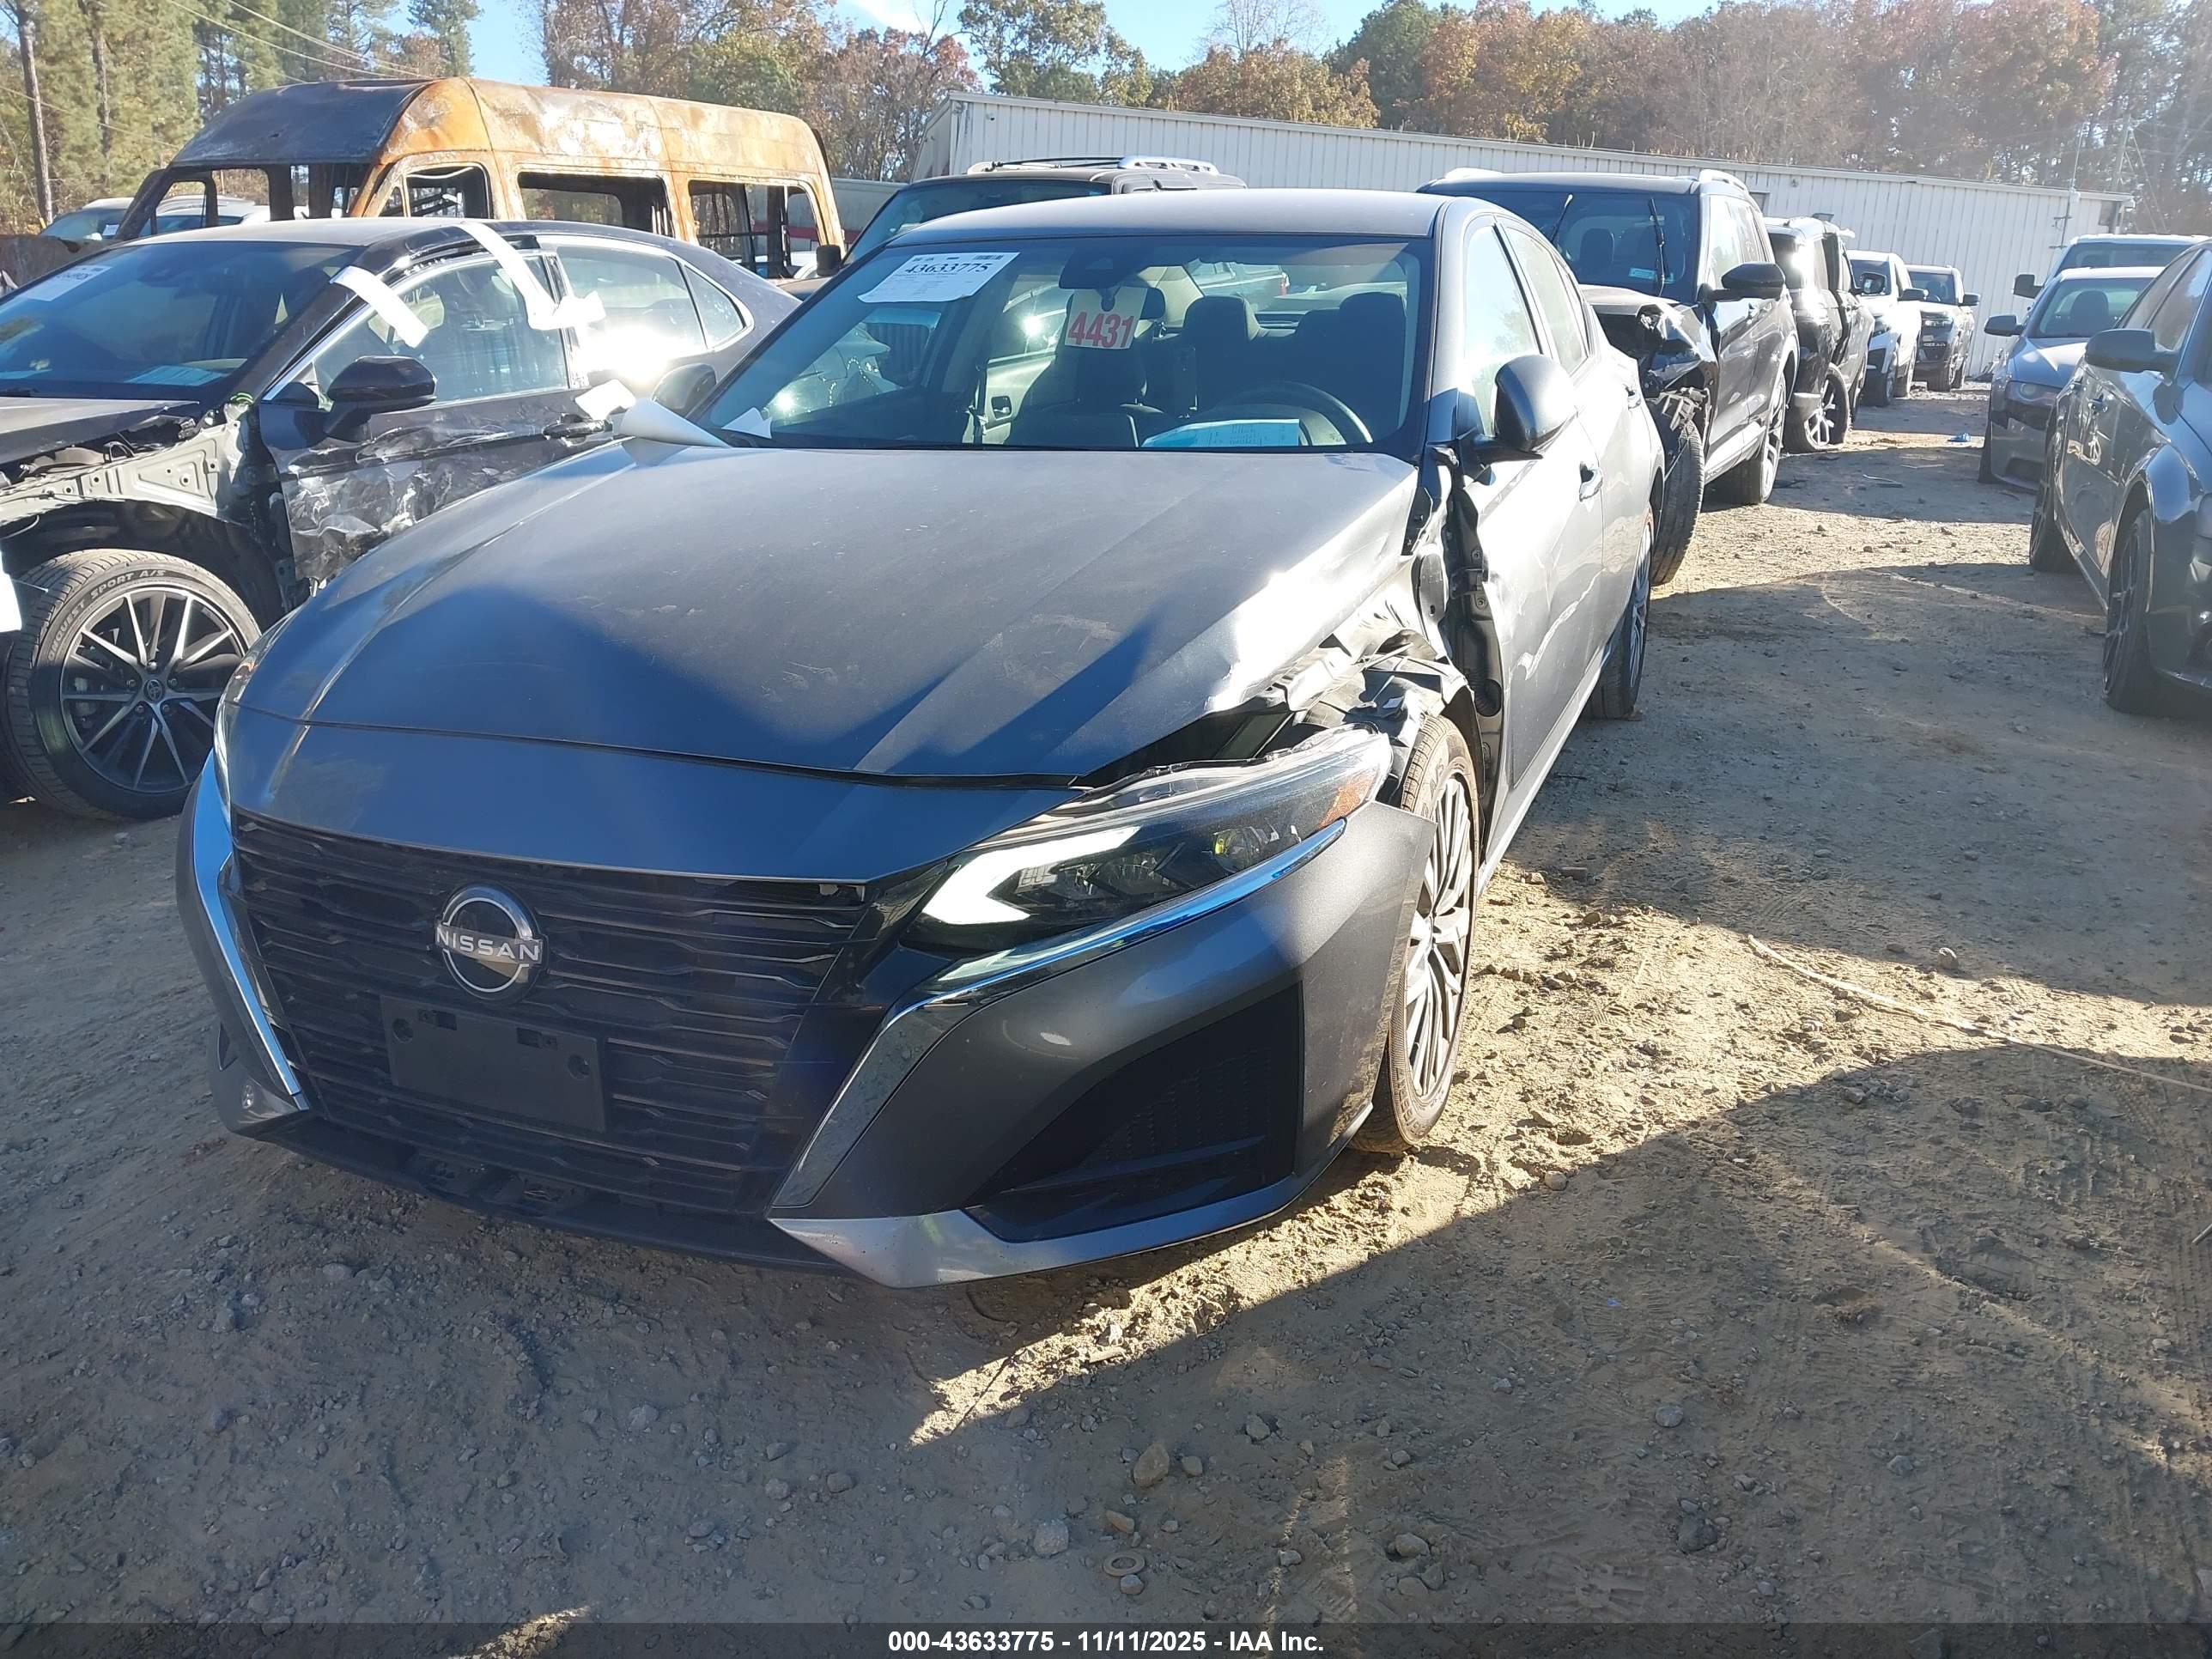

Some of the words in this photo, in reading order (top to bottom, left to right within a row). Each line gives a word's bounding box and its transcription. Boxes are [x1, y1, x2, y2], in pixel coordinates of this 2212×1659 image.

[905, 263, 994, 274] 43633775
[1067, 312, 1134, 348] 4431
[48, 599, 85, 661] ONQUEST
[90, 573, 134, 599] SPORT
[436, 927, 538, 961] NISSAN
